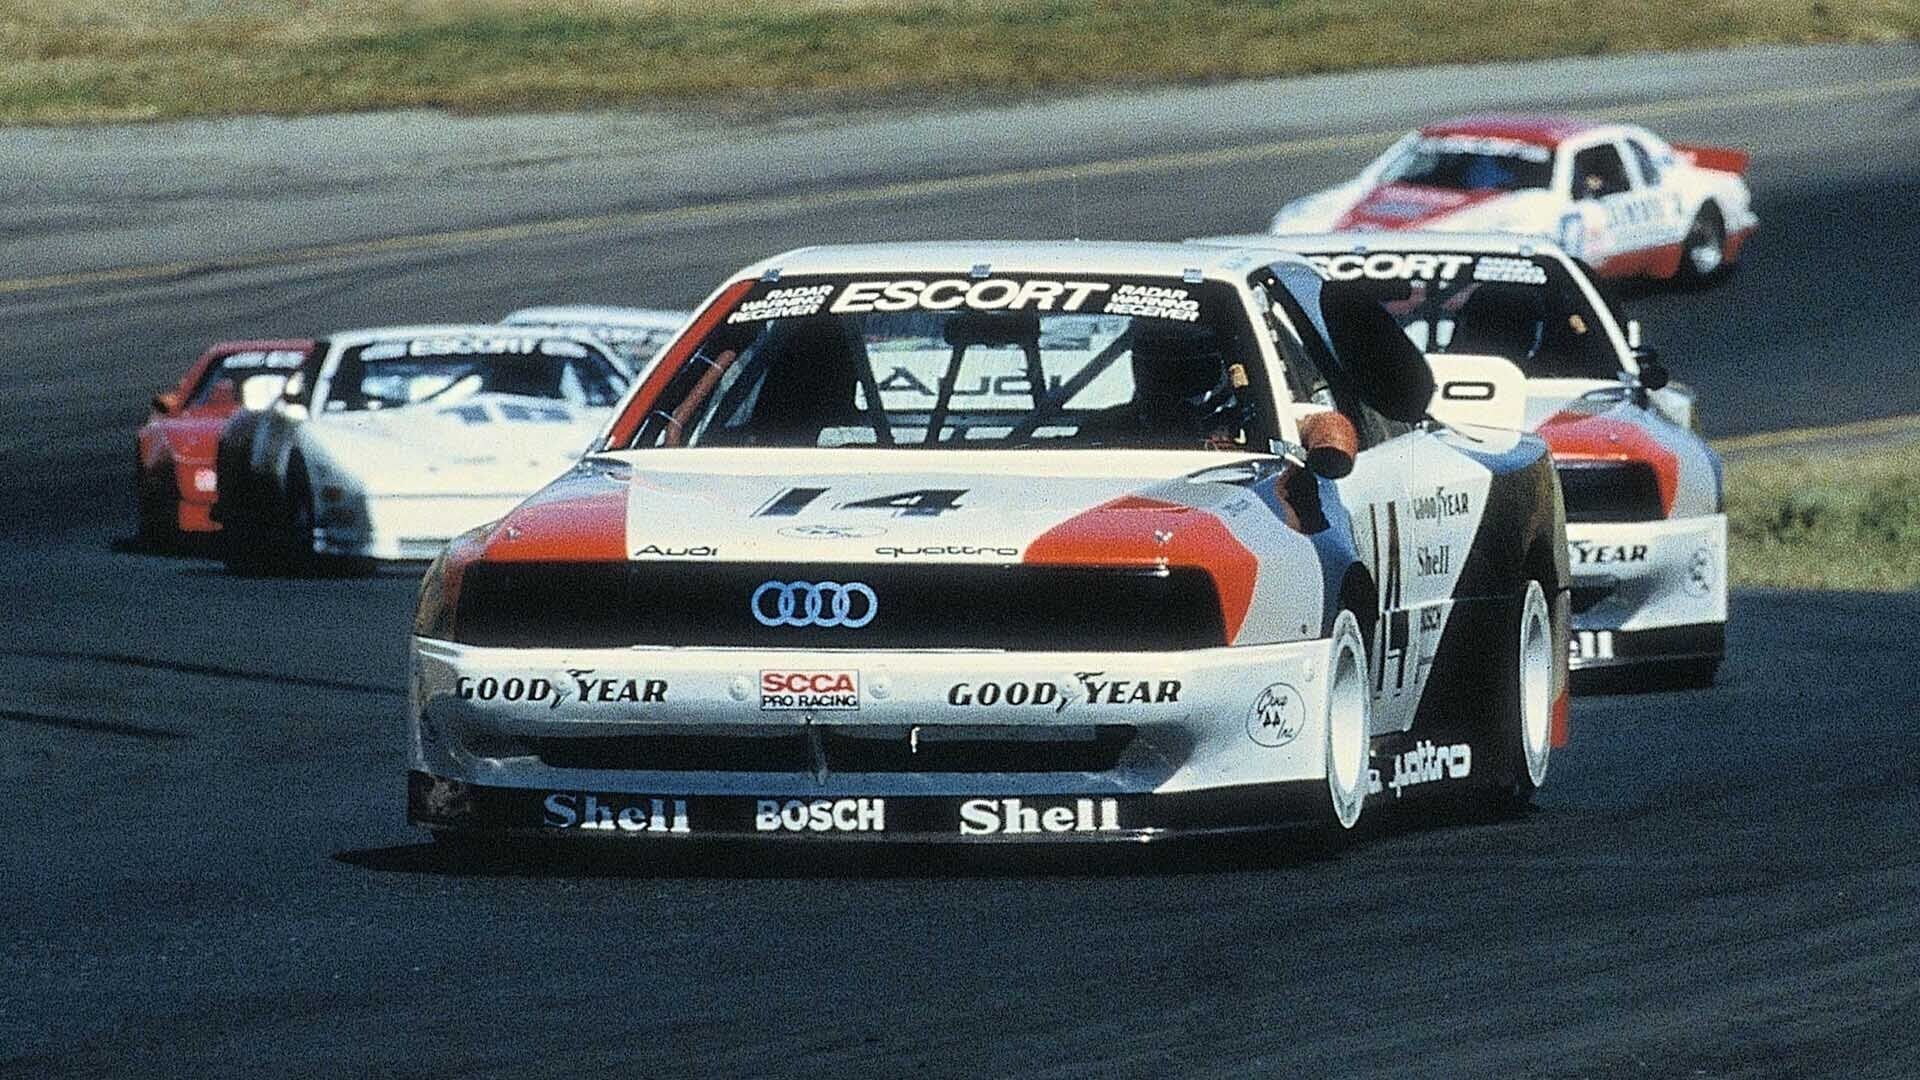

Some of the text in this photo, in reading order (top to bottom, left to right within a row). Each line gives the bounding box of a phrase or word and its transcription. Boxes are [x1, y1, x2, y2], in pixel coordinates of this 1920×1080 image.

[766, 285, 834, 300] RADAR
[829, 280, 1110, 313] ESCORT
[1118, 284, 1188, 300] RADAR
[741, 296, 826, 312] WARNING
[1111, 293, 1200, 312] WARNING
[727, 304, 819, 324] RECEIVER
[1104, 303, 1199, 322] RECEIVER
[750, 487, 970, 518] 14
[634, 544, 717, 557] Audi
[875, 546, 1018, 558] quattro
[1579, 545, 1648, 563] YEAR
[1417, 545, 1449, 577] Shell
[762, 673, 855, 693] SCCA
[762, 695, 857, 707] PRO RACING
[543, 795, 691, 833] Shell
[755, 798, 886, 831] BOSCH
[959, 798, 1121, 836] Shell
